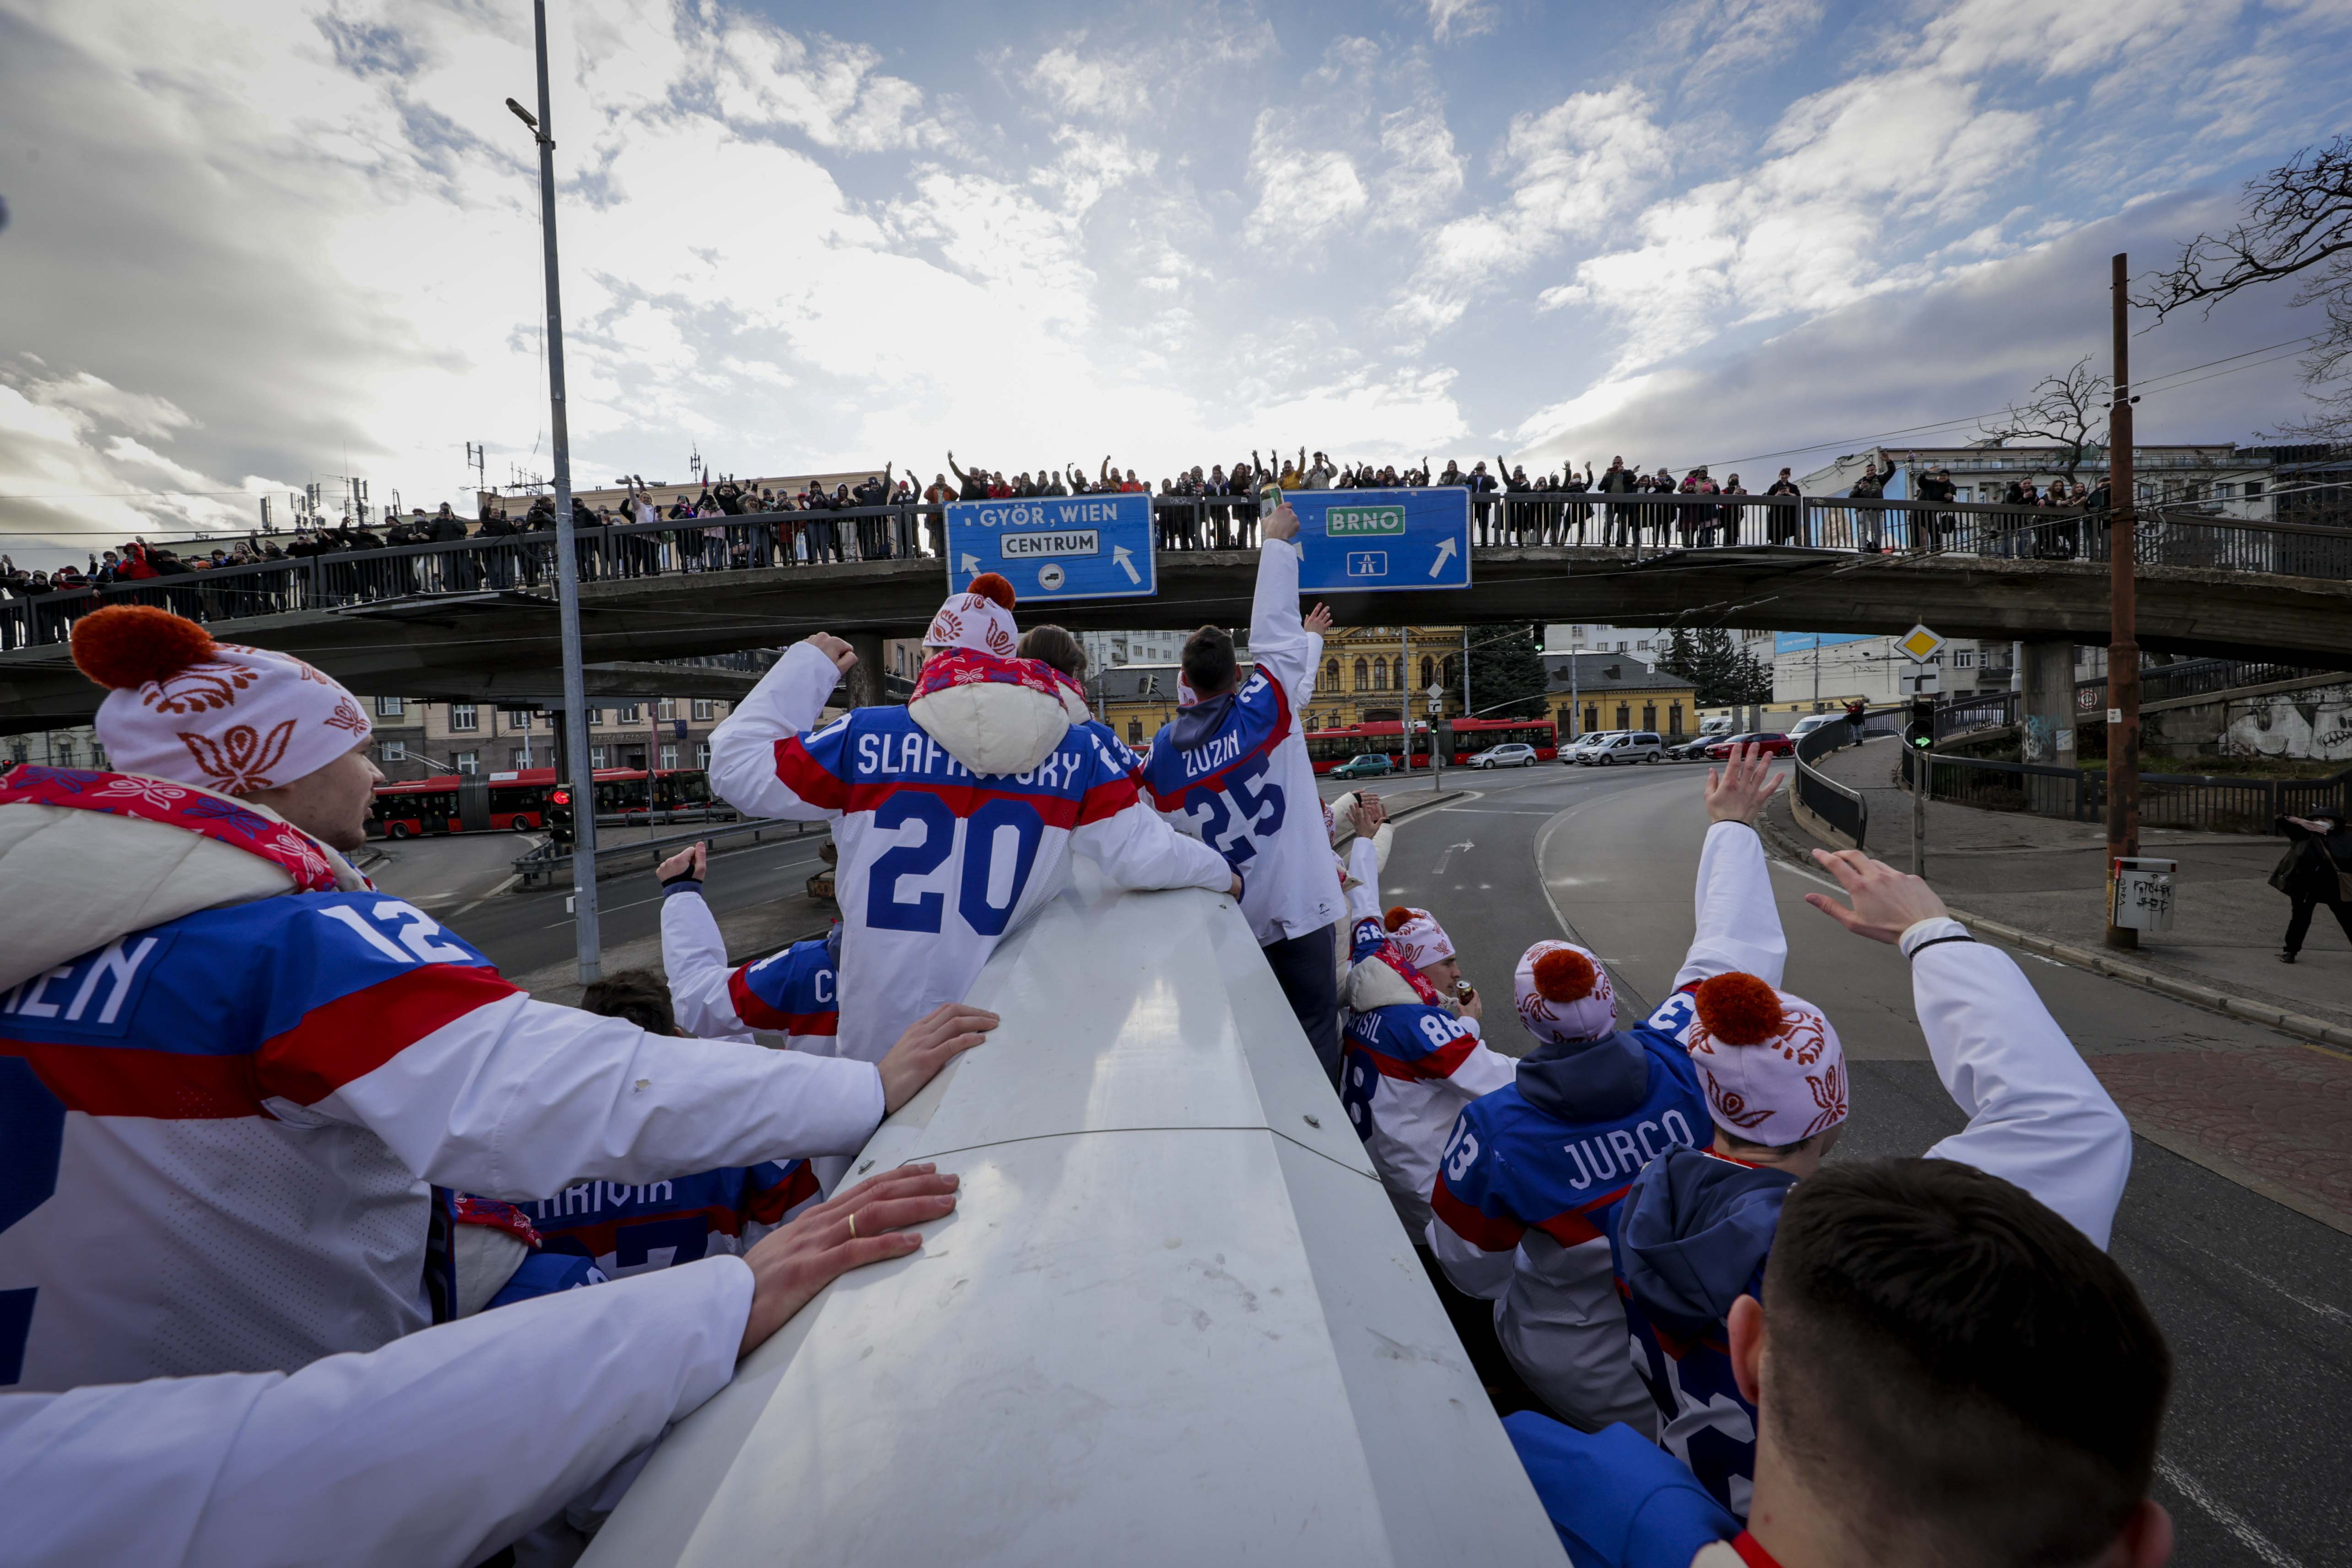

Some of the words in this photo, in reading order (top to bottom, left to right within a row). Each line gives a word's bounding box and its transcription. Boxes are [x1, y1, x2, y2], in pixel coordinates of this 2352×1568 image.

[1059, 503, 1117, 522] WIEN
[1332, 511, 1399, 531] BRNO
[1006, 535, 1094, 553] CENTRUM
[858, 732, 1081, 790] SLAFKY
[1182, 730, 1240, 778] ZUZIN
[1184, 750, 1286, 865] 25
[866, 790, 1045, 936] 20
[318, 900, 474, 964] 12
[815, 970, 839, 1002] C
[1420, 1014, 1468, 1047] 88
[1444, 1114, 1479, 1181] 13
[1563, 1109, 1695, 1190] JURCO
